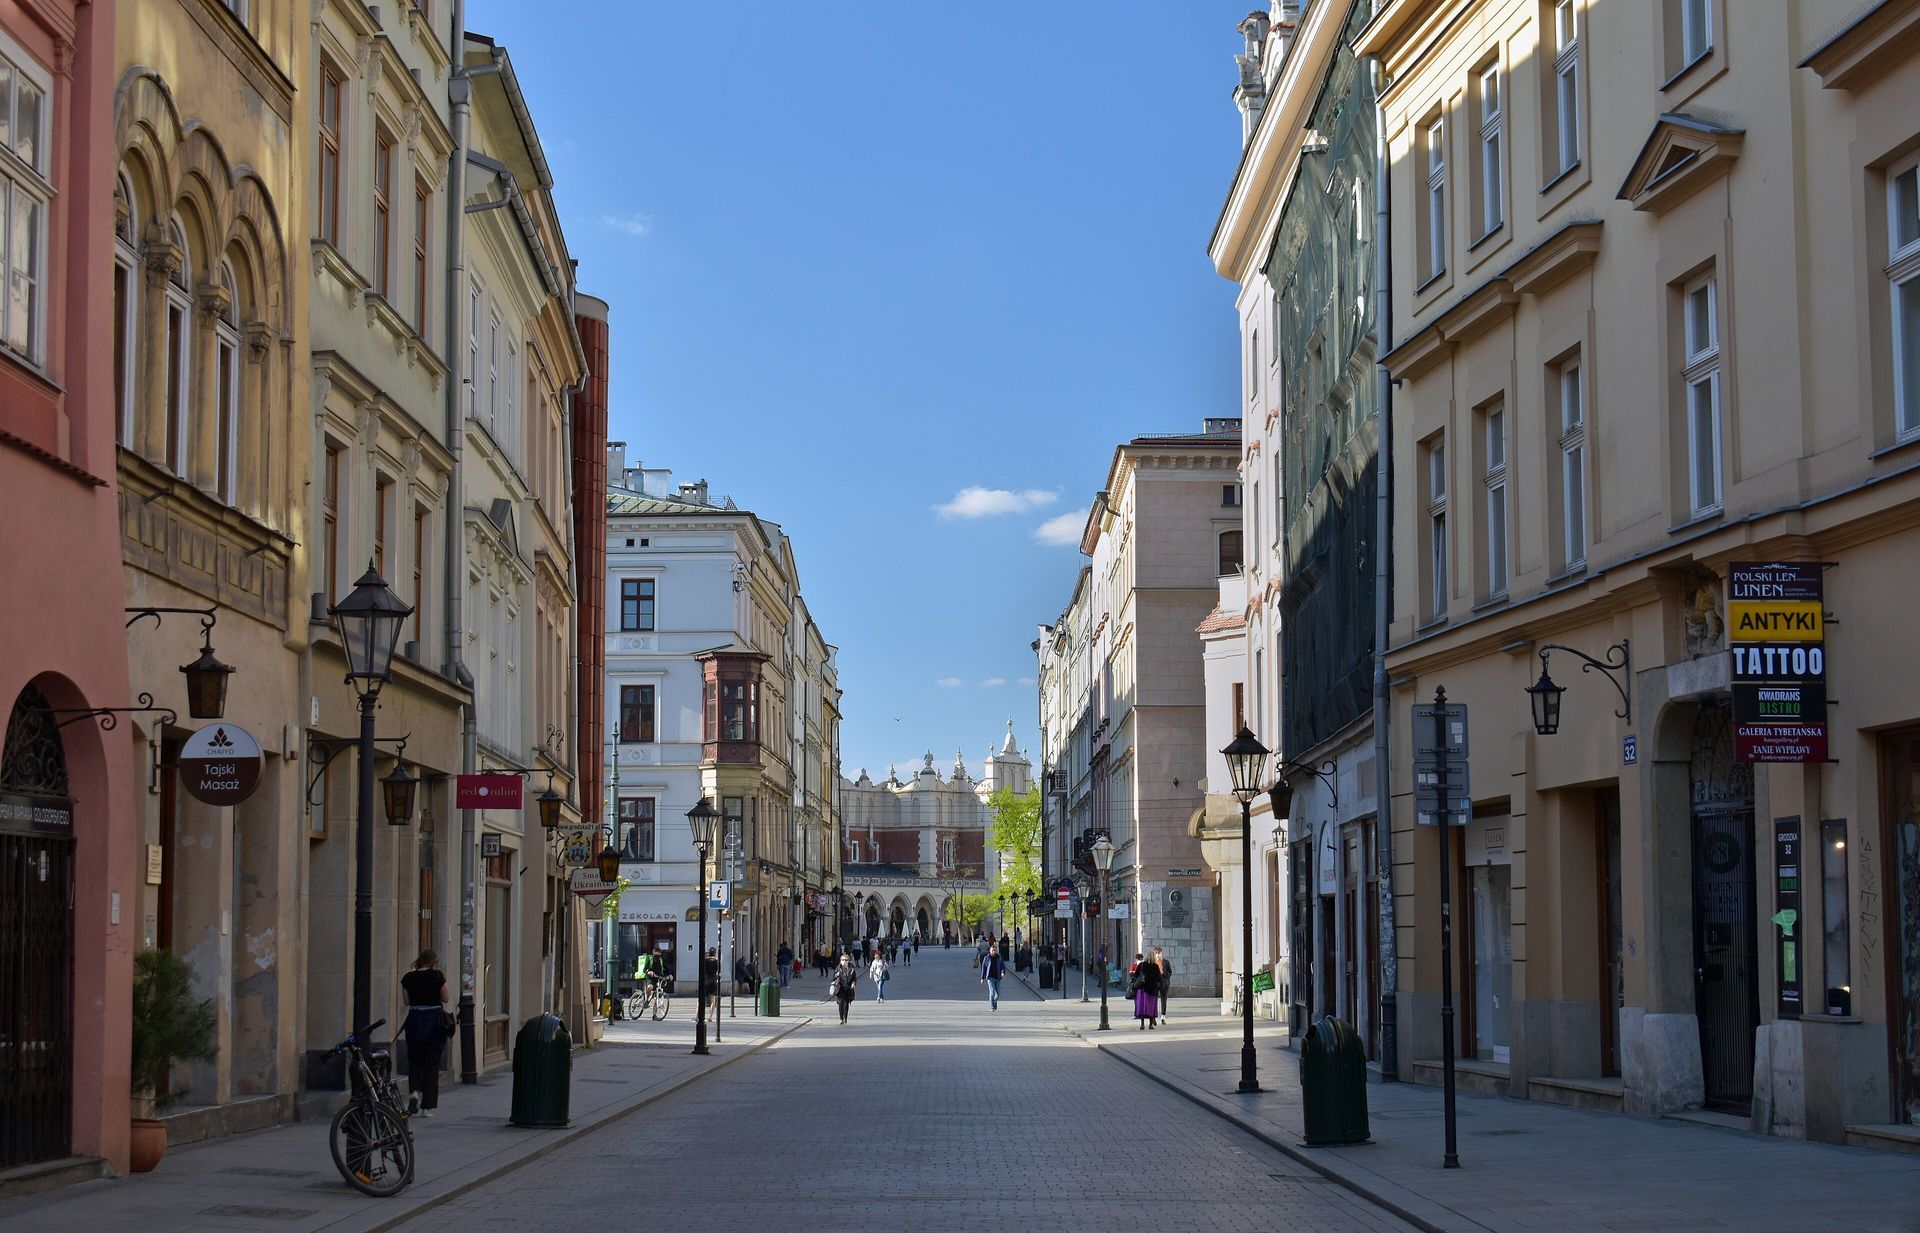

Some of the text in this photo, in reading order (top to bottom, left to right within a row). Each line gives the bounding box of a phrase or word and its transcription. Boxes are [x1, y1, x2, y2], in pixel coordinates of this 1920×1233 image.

[1734, 572, 1772, 581] POLSKI
[1775, 572, 1797, 582] LEN
[1734, 584, 1784, 597] LINEN
[1739, 612, 1816, 630] ANTYKI
[1733, 648, 1823, 675] TATTOO
[1759, 691, 1801, 701] KWADRANS
[1760, 703, 1801, 714] BISTRO
[1739, 726, 1822, 736] GALERIA TYBETAŃSKA
[1625, 745, 1635, 760] 32
[1753, 746, 1811, 754] TANIE WYPRAWY
[204, 764, 235, 777] Tajski
[200, 779, 240, 790] Masaż
[462, 786, 518, 796] red rubin
[1778, 833, 1798, 842] GRODZKA
[487, 844, 497, 853] 23
[1785, 845, 1792, 855] 32
